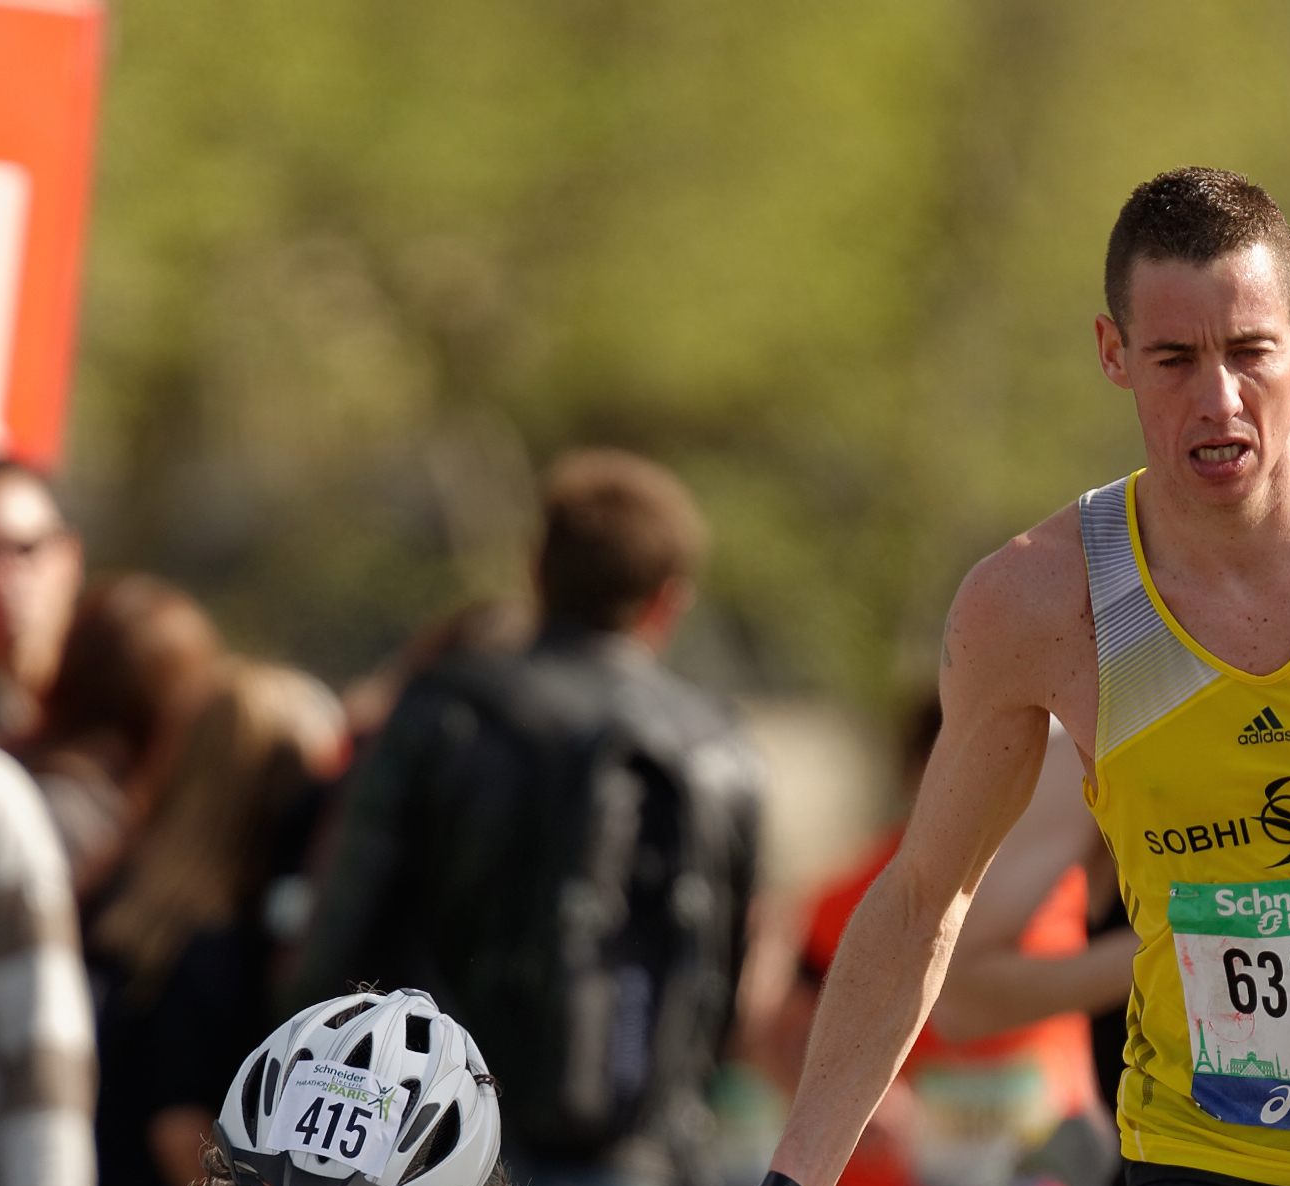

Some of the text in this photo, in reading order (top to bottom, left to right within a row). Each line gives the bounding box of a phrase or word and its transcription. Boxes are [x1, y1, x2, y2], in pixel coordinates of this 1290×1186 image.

[1144, 817, 1251, 855] SOBHI
[313, 1064, 366, 1082] Schneider
[331, 1076, 363, 1088] Electric
[295, 1080, 330, 1088] MARATHON
[327, 1082, 369, 1102] PARIS
[294, 1096, 373, 1159] 415
